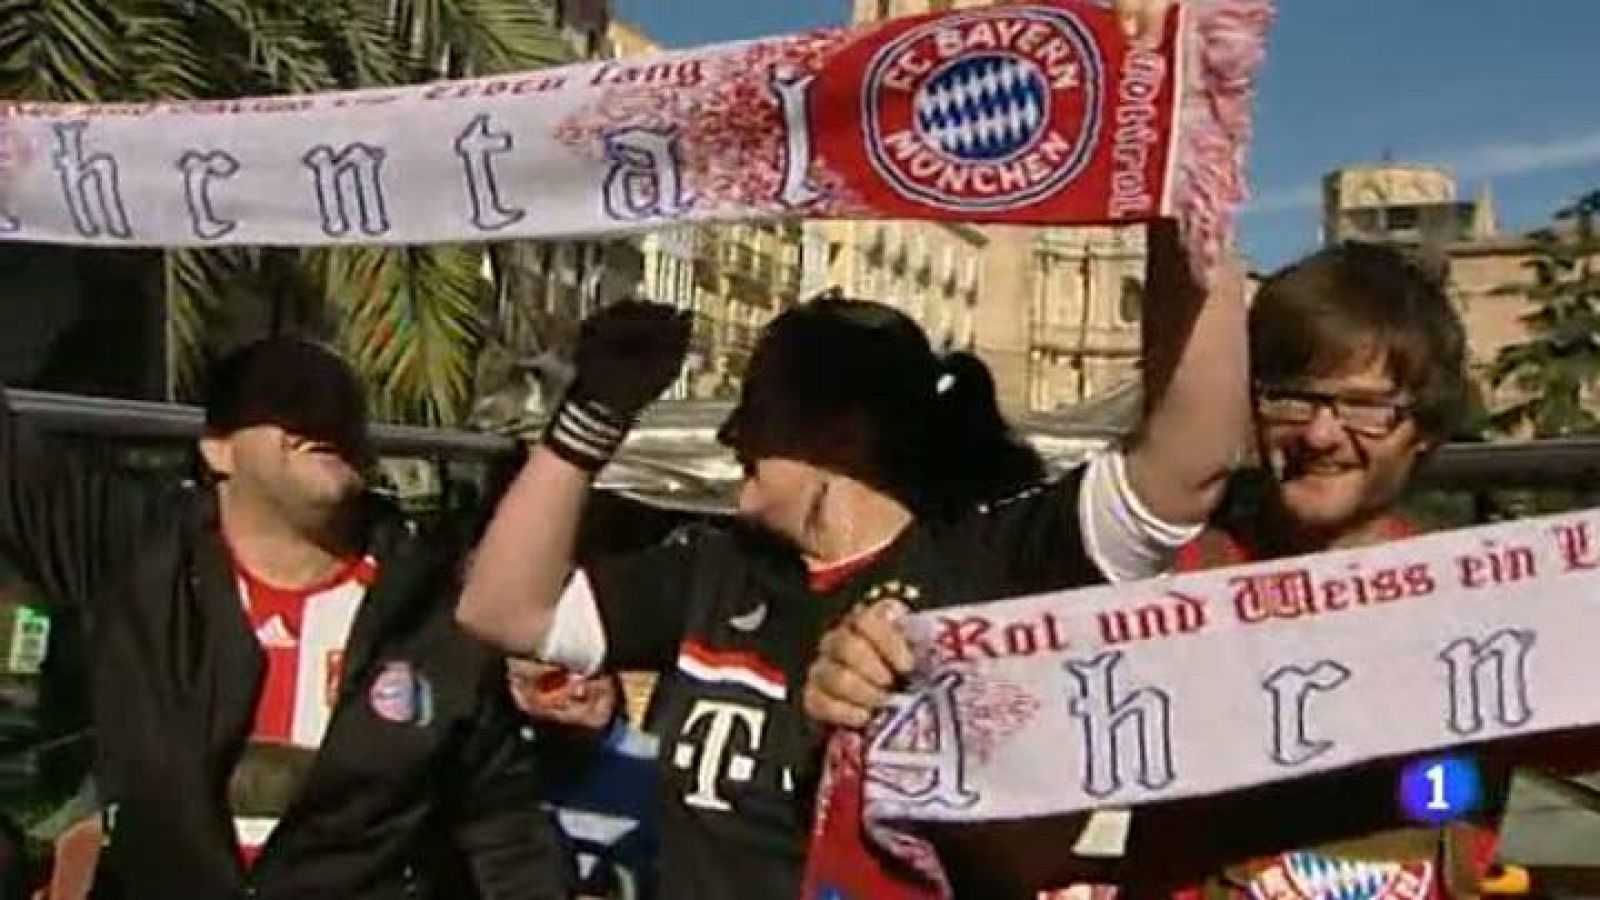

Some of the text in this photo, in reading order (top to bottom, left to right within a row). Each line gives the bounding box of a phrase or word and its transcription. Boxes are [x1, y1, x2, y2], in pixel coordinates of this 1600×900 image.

[882, 20, 1081, 90] FC BAYERN
[0, 64, 834, 239] hrntal
[936, 611, 1070, 662] Rot
[1095, 591, 1206, 645] und
[1227, 561, 1436, 623] Weiss
[1455, 538, 1538, 589] ein
